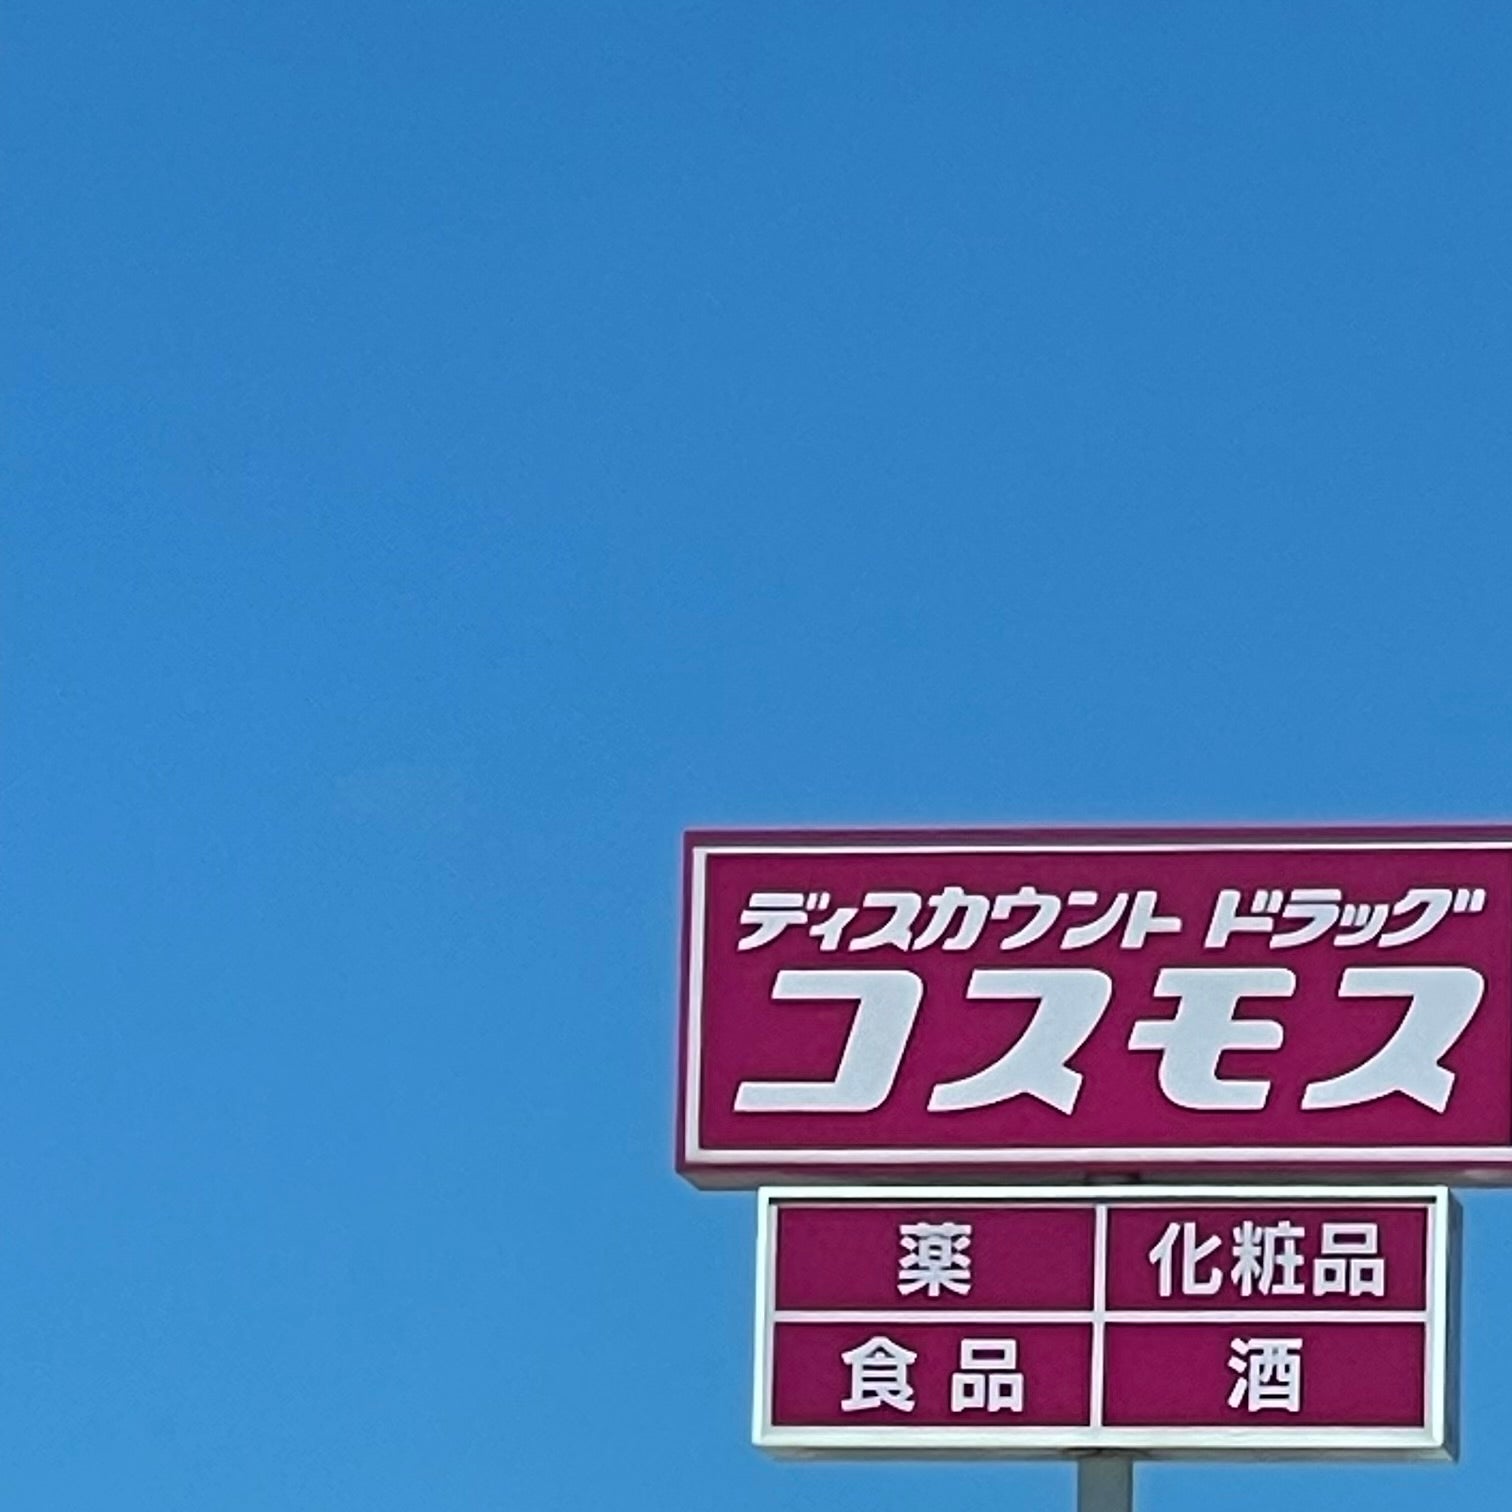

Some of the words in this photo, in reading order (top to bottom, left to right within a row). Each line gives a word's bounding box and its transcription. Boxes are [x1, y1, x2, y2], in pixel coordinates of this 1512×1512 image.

[736, 886, 1182, 952] ディスカウント
[1203, 886, 1488, 951] ドラッグ
[733, 966, 1486, 1116] コスモス
[896, 1222, 973, 1297] 薬
[1148, 1222, 1386, 1297] 化粧品
[840, 1335, 1025, 1413] 食品
[1226, 1337, 1302, 1413] 酒
